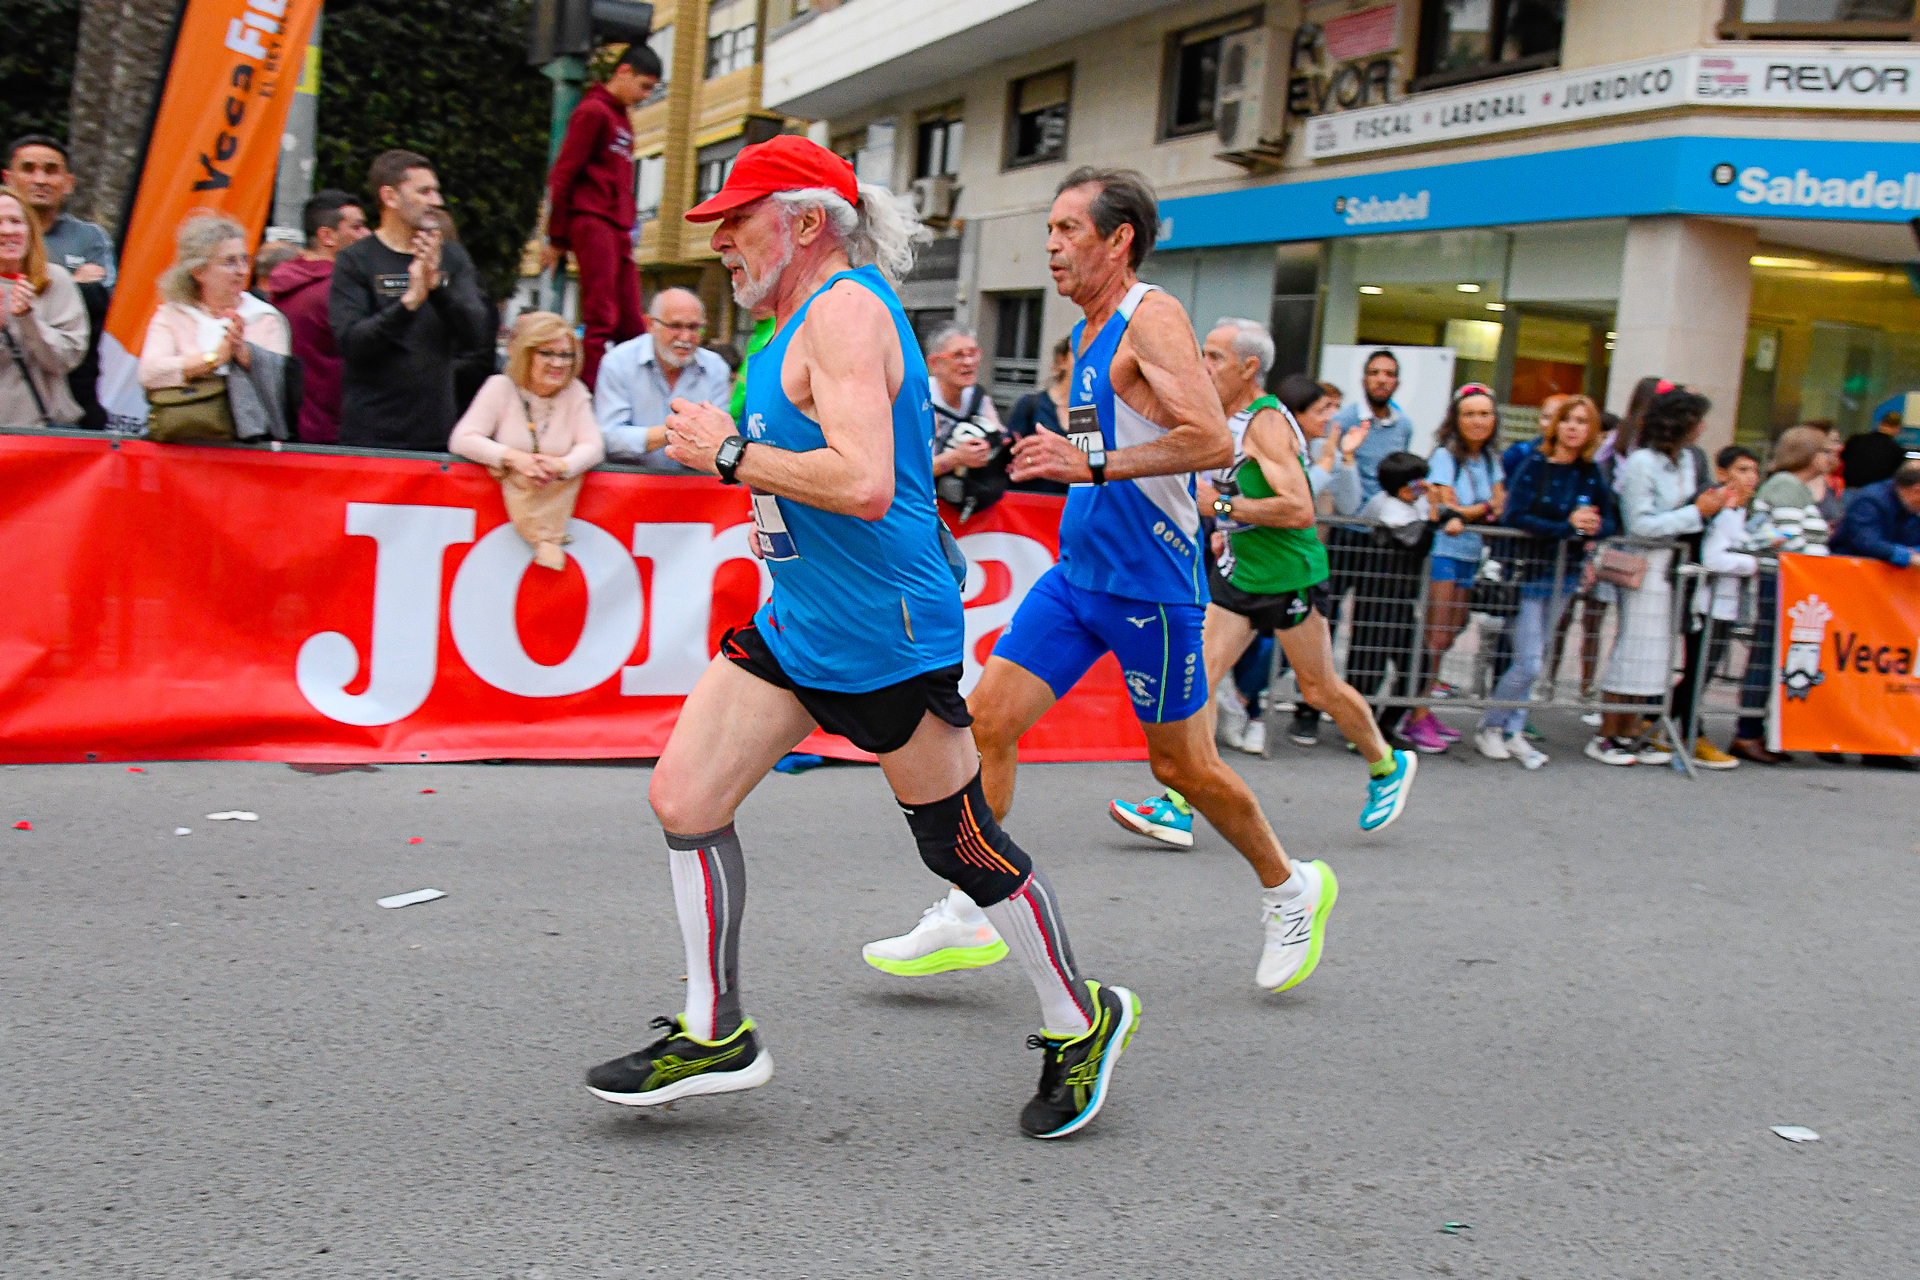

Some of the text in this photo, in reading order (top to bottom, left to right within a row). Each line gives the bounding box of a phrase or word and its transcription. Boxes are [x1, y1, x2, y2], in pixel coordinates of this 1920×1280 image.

[1764, 64, 1910, 93] REVOR
[1353, 67, 1674, 140] FISCAL LABORAL JURIDICO
[1345, 189, 1431, 226] Sabadell
[1736, 166, 1920, 211] Sabadell
